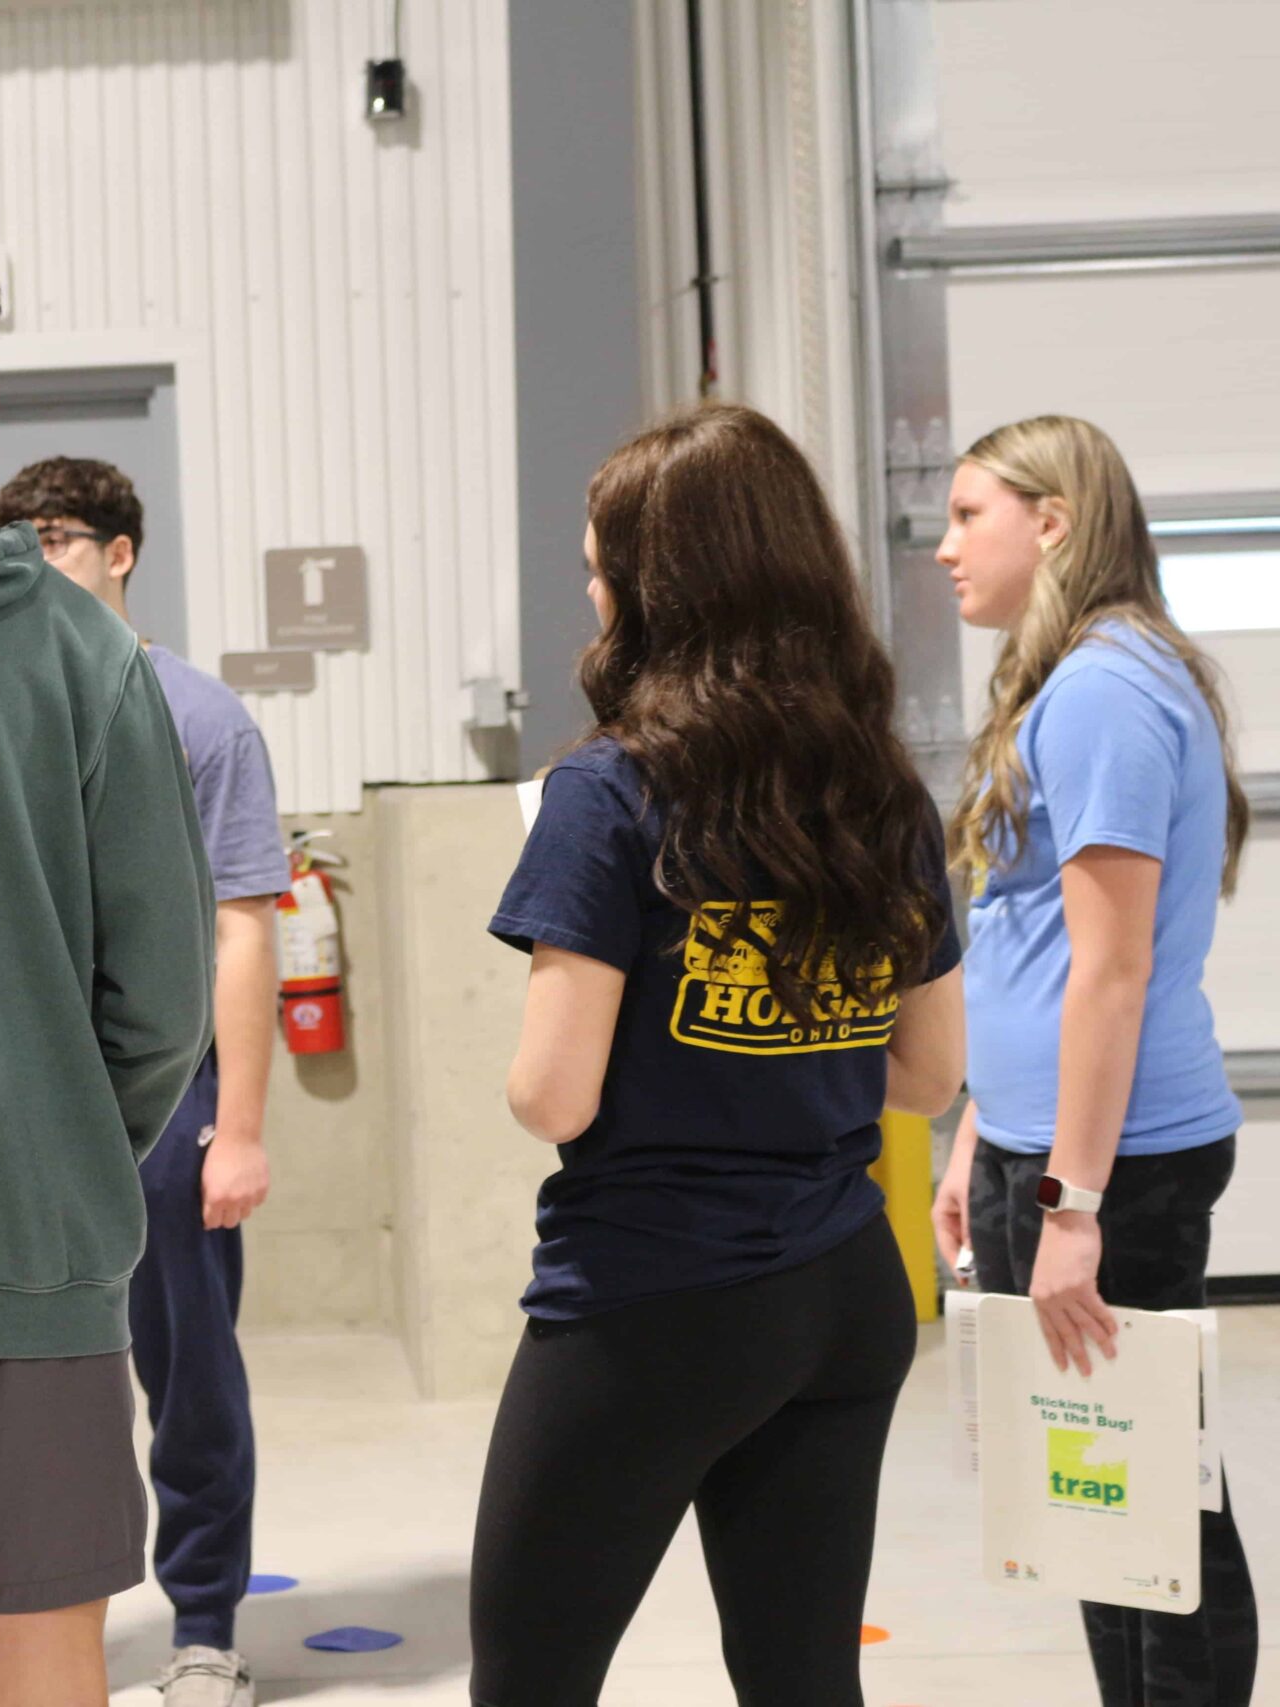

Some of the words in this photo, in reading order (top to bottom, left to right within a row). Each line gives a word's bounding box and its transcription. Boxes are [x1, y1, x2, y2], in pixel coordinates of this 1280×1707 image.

[790, 1023, 850, 1043] OHIO
[1030, 1395, 1089, 1413] Sticking
[1094, 1402, 1104, 1413] it
[1041, 1409, 1057, 1421] to
[1064, 1412, 1090, 1425] the
[1096, 1415, 1133, 1432] Bug!
[1051, 1471, 1125, 1506] trap
